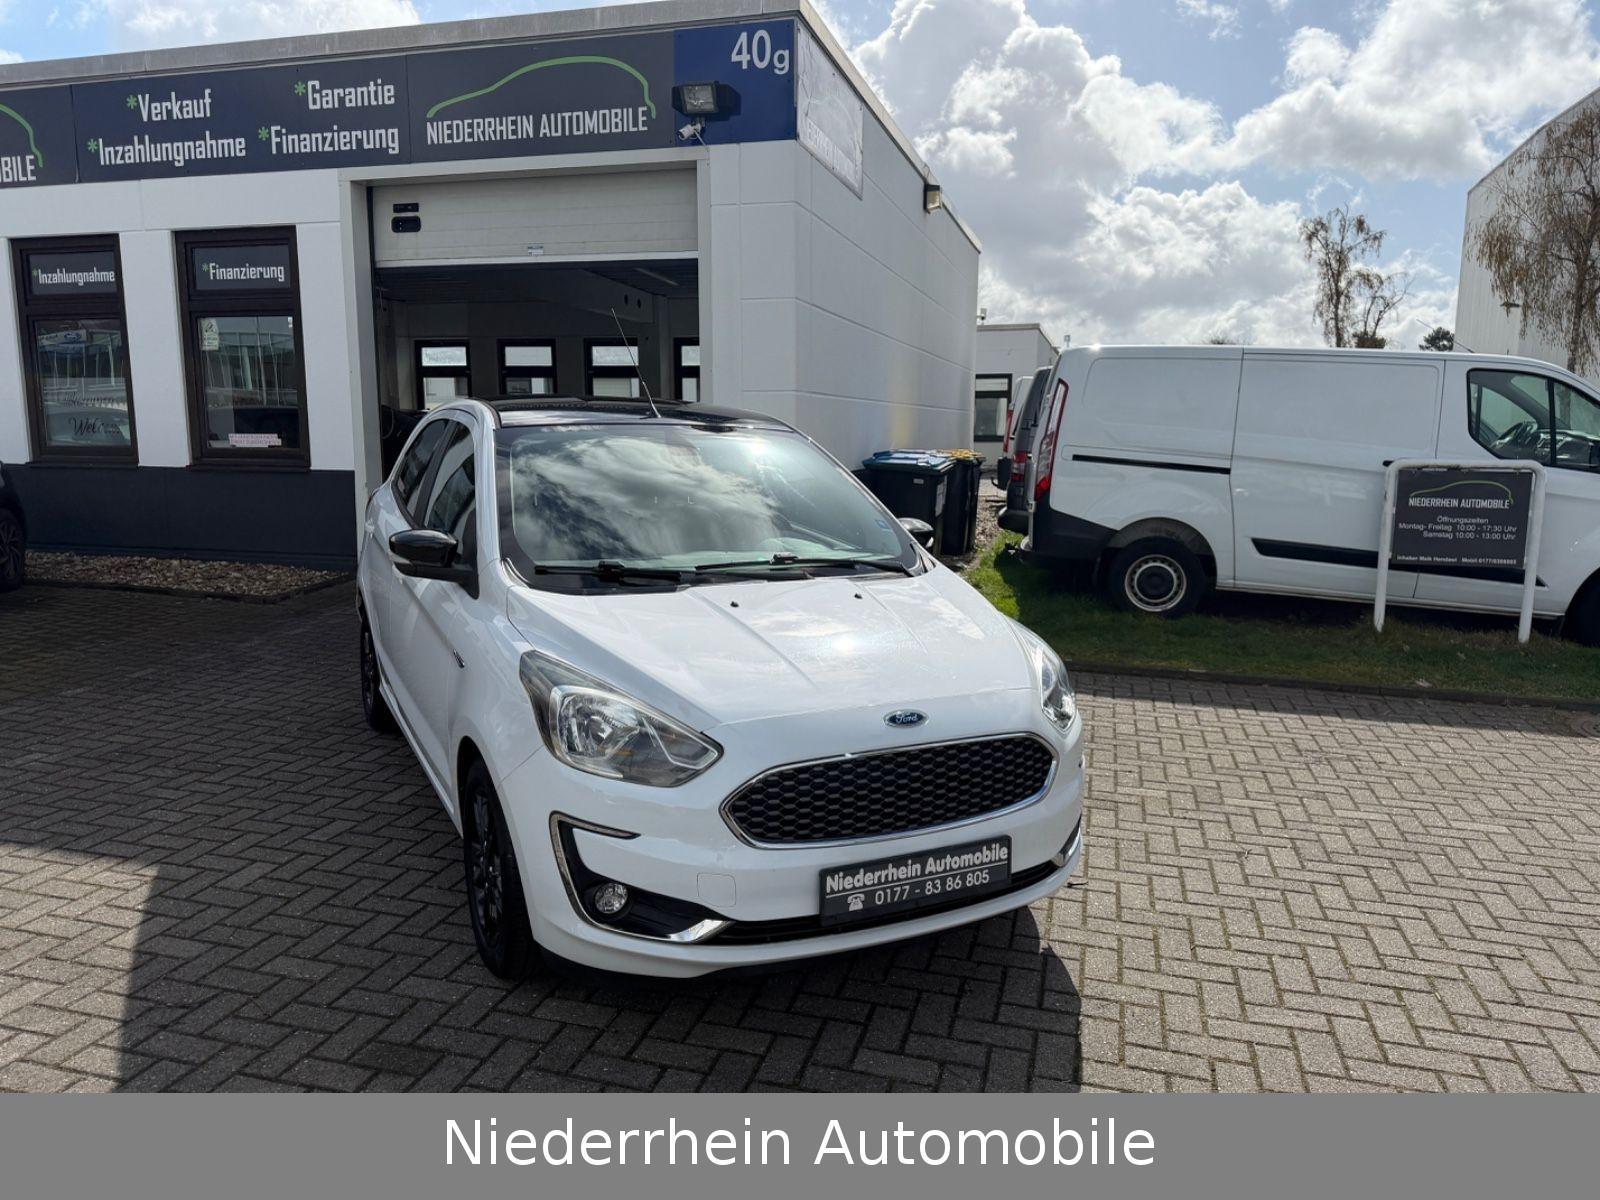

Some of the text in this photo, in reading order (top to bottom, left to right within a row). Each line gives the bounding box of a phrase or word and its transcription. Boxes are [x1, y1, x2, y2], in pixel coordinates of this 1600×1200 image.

[731, 28, 790, 75] 40g
[426, 106, 649, 145] NIEDERRHEIN AUTOMOBILE
[0, 154, 37, 183] BILE
[1408, 497, 1510, 509] NIEDERRHEIN AUTOMOBILE
[1428, 523, 1453, 531] Freitag
[1437, 515, 1489, 524] Öffnungszeiten
[1423, 531, 1453, 539] Samstag
[895, 711, 919, 724] Ford
[826, 843, 1009, 893] Niederrhein Automobile
[875, 886, 910, 905] 0177
[925, 880, 942, 895] 83
[946, 874, 963, 890] 86
[966, 869, 990, 887] 805
